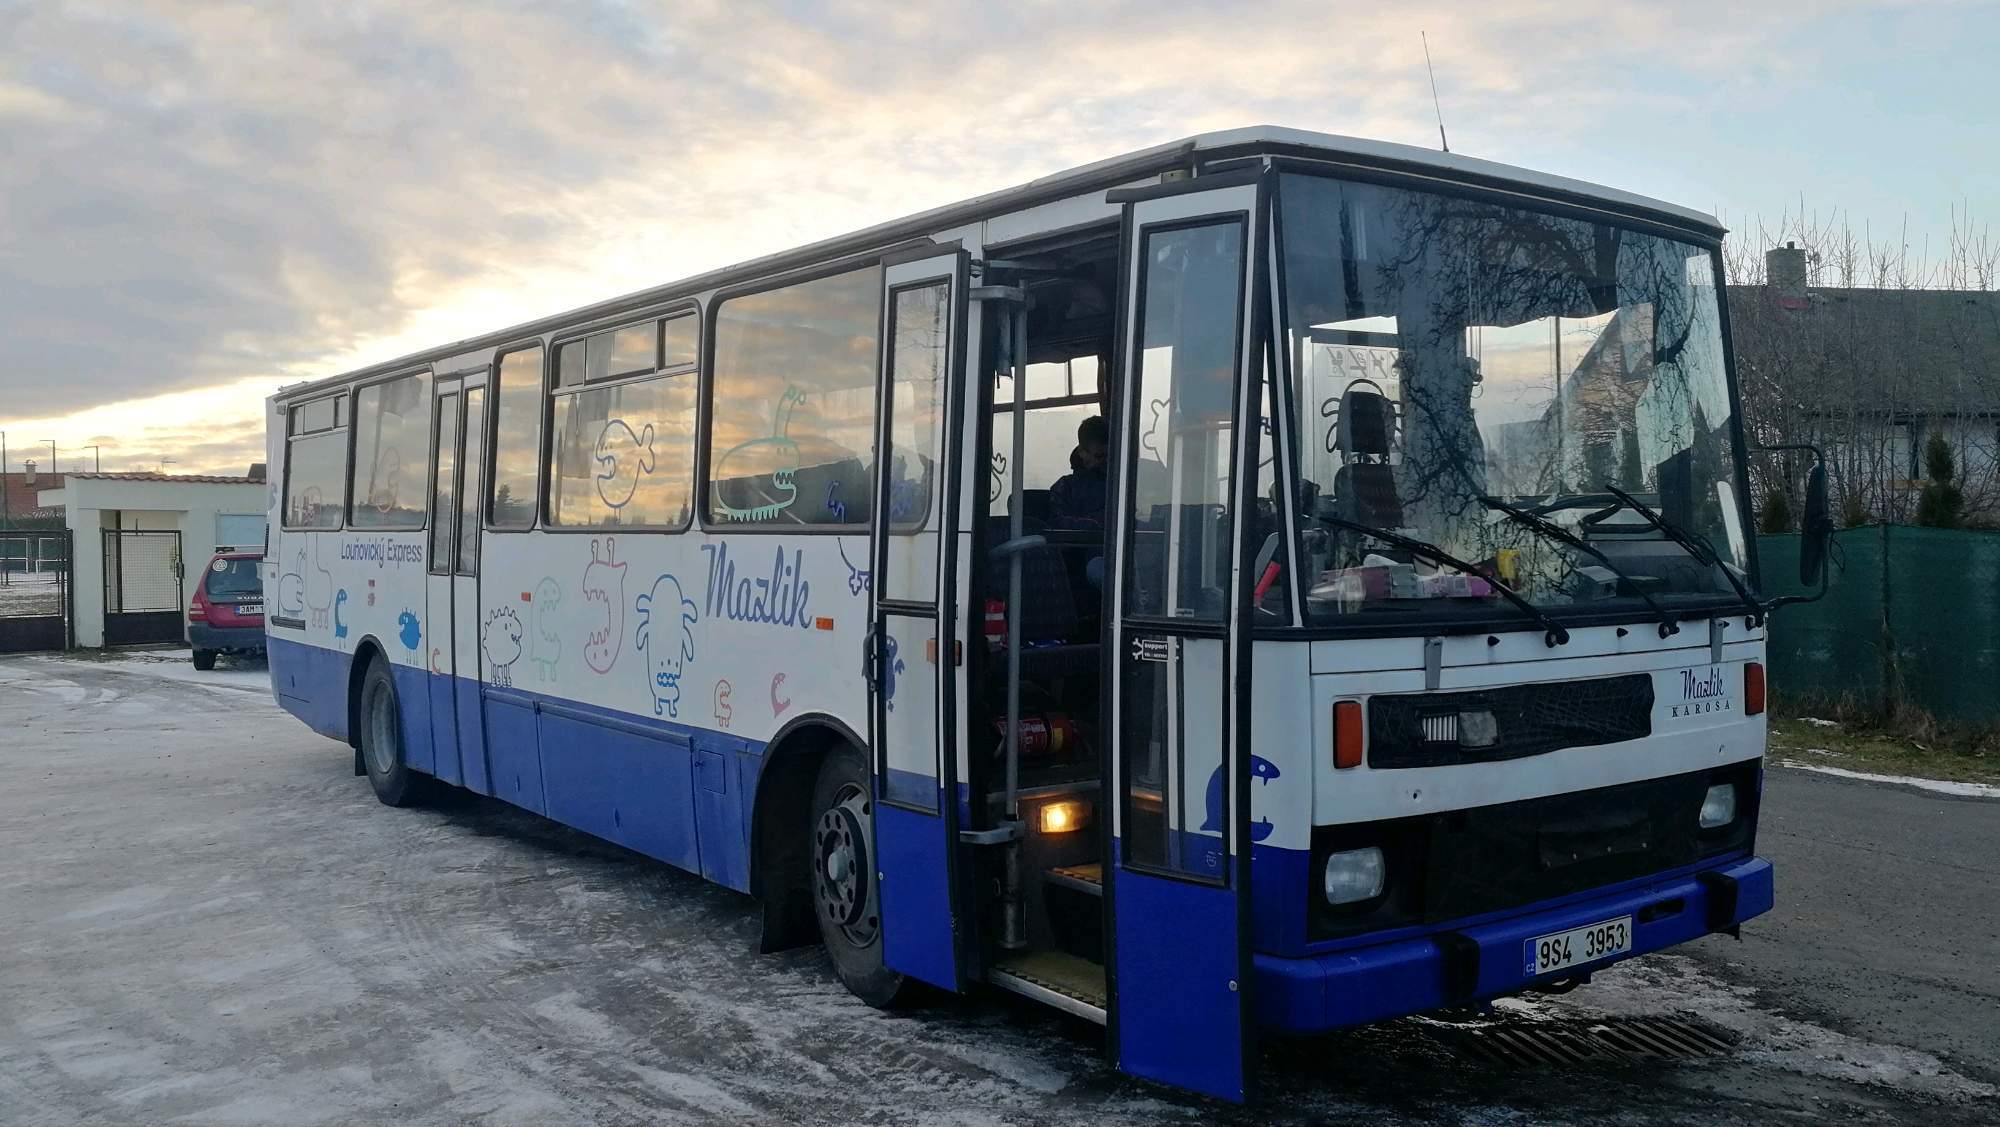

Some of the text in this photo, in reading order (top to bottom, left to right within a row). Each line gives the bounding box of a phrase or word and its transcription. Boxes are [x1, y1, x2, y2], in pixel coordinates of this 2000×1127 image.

[341, 537, 422, 569] Louňovický Express
[701, 541, 812, 628] Mazlik
[1672, 699, 1730, 717] KAROSA
[1540, 923, 1625, 968] 9S4 3953
[1526, 963, 1535, 973] CZ
